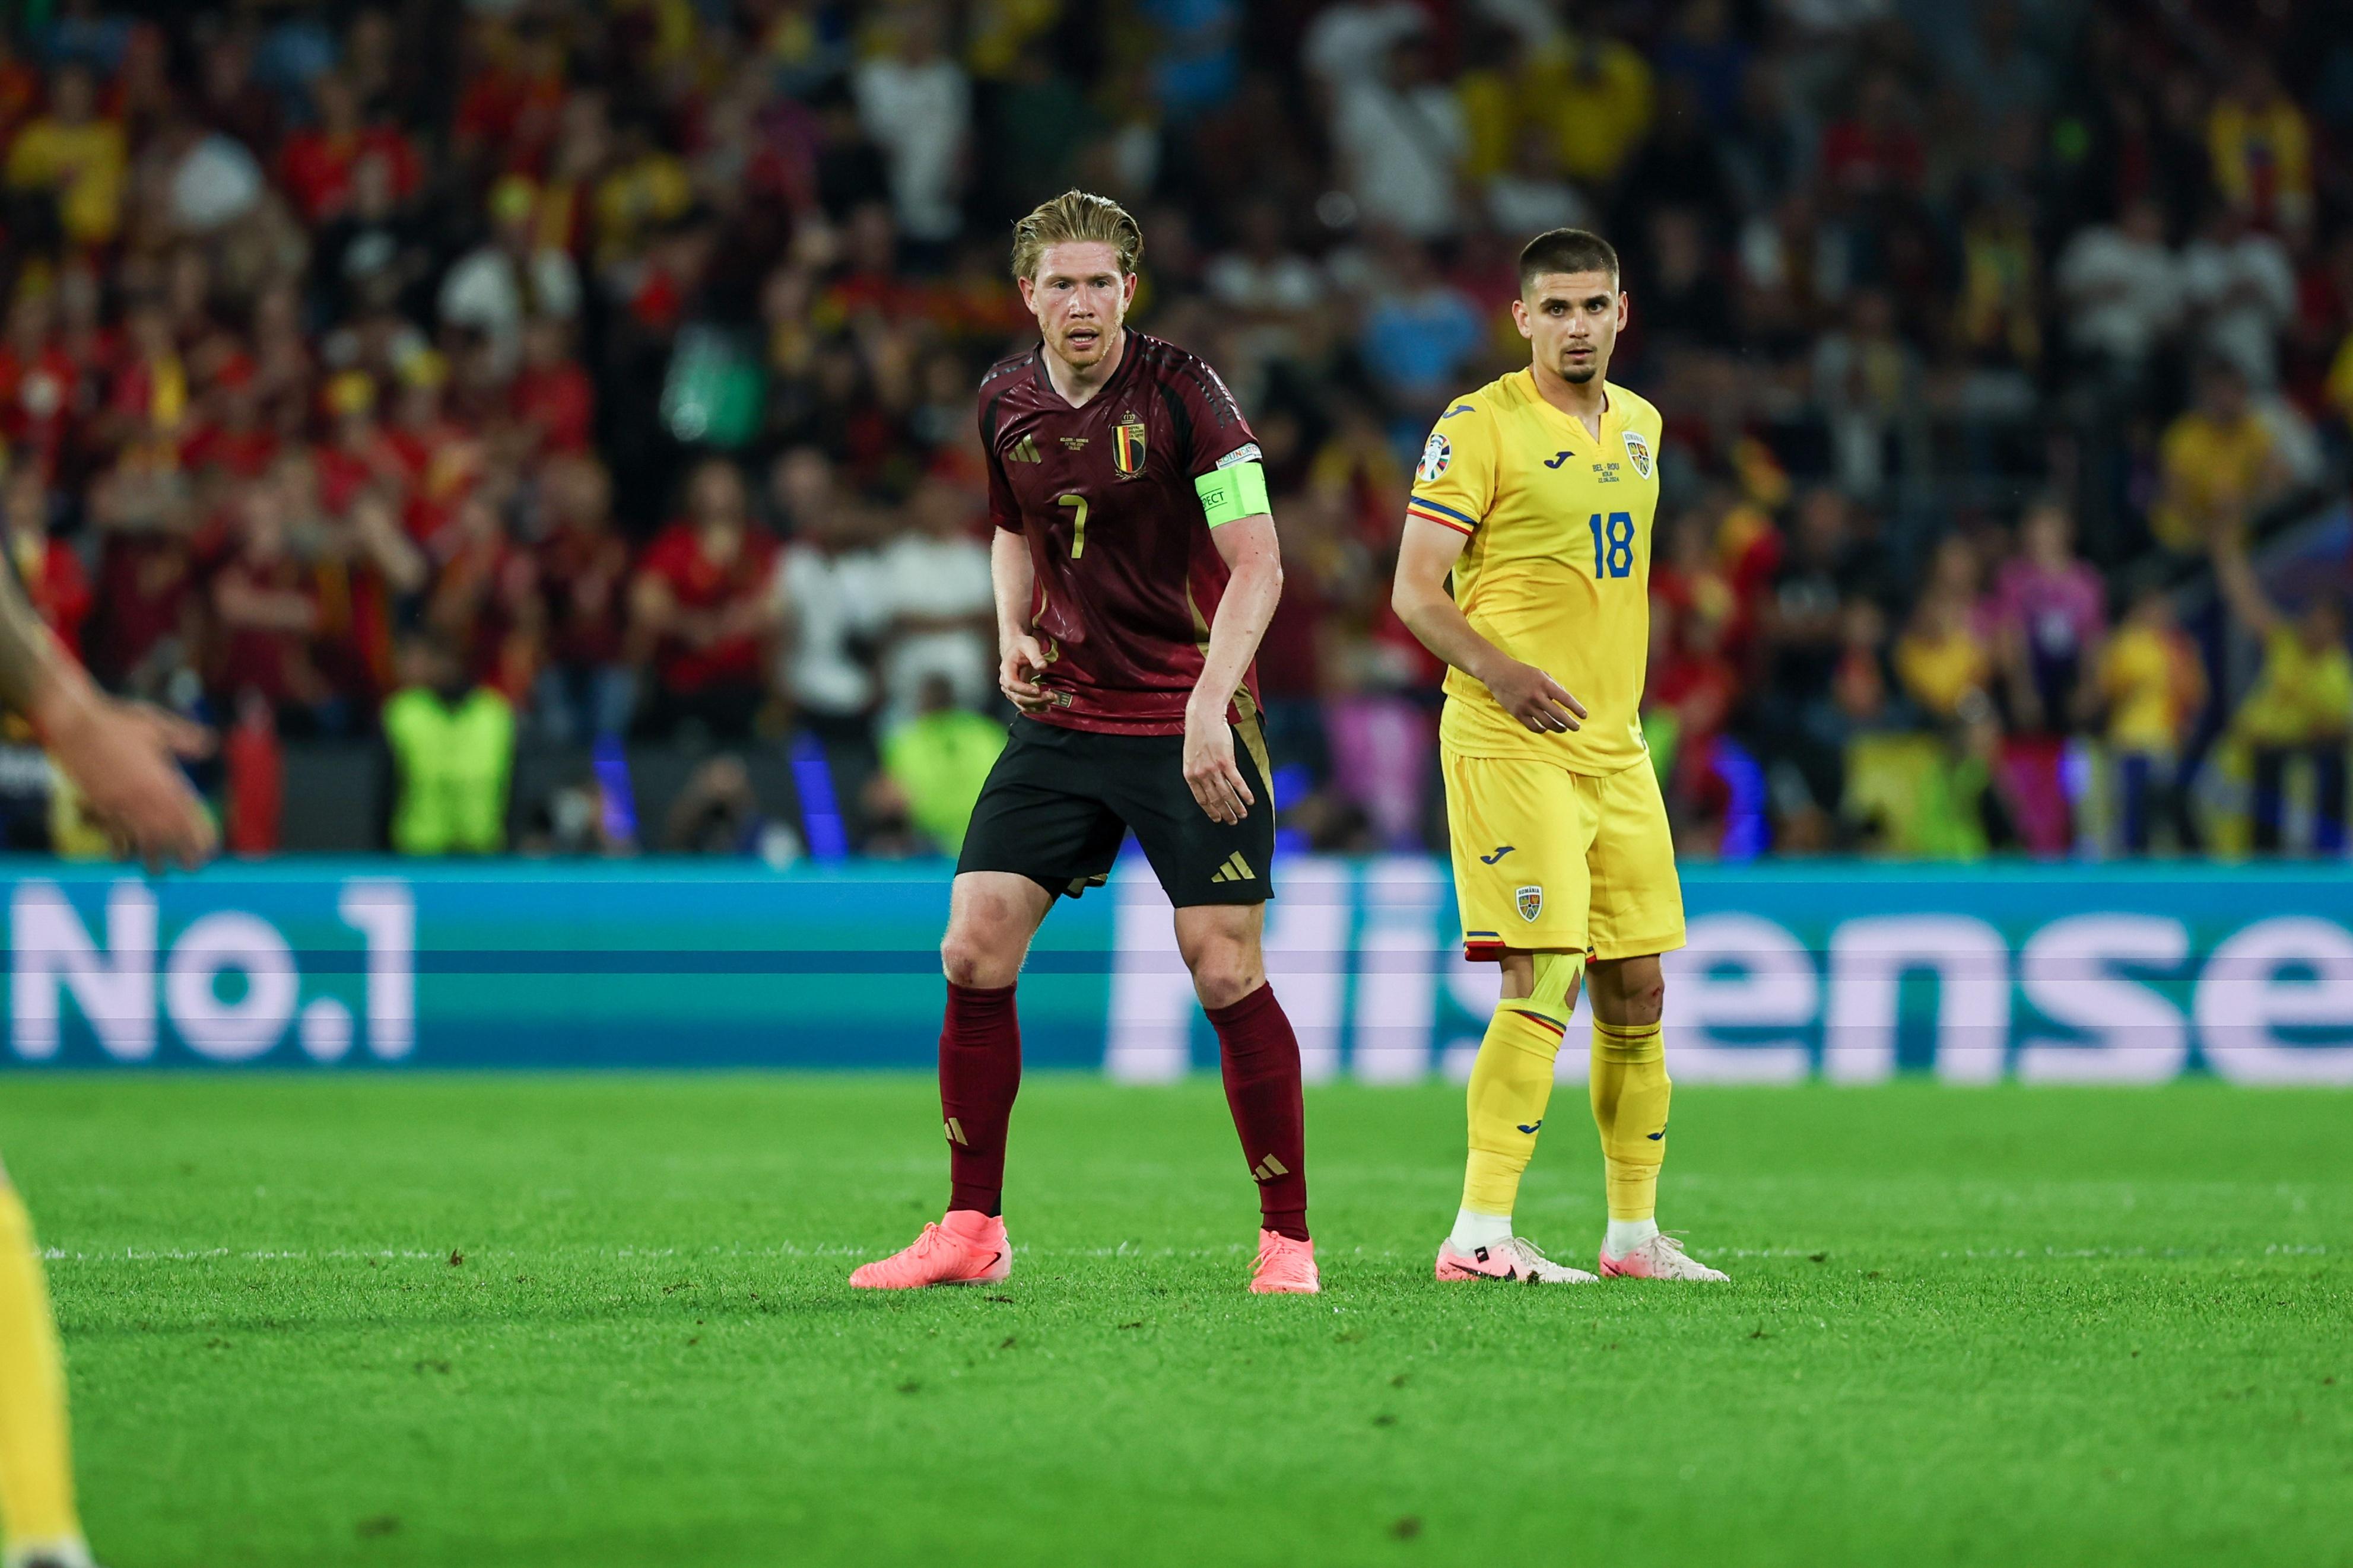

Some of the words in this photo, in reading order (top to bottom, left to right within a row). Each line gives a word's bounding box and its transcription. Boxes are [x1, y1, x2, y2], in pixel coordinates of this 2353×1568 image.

[1058, 494, 1088, 559] 7
[1589, 512, 1635, 579] 18
[9, 877, 417, 1062] No.1
[1104, 857, 2353, 1084] Hiense
